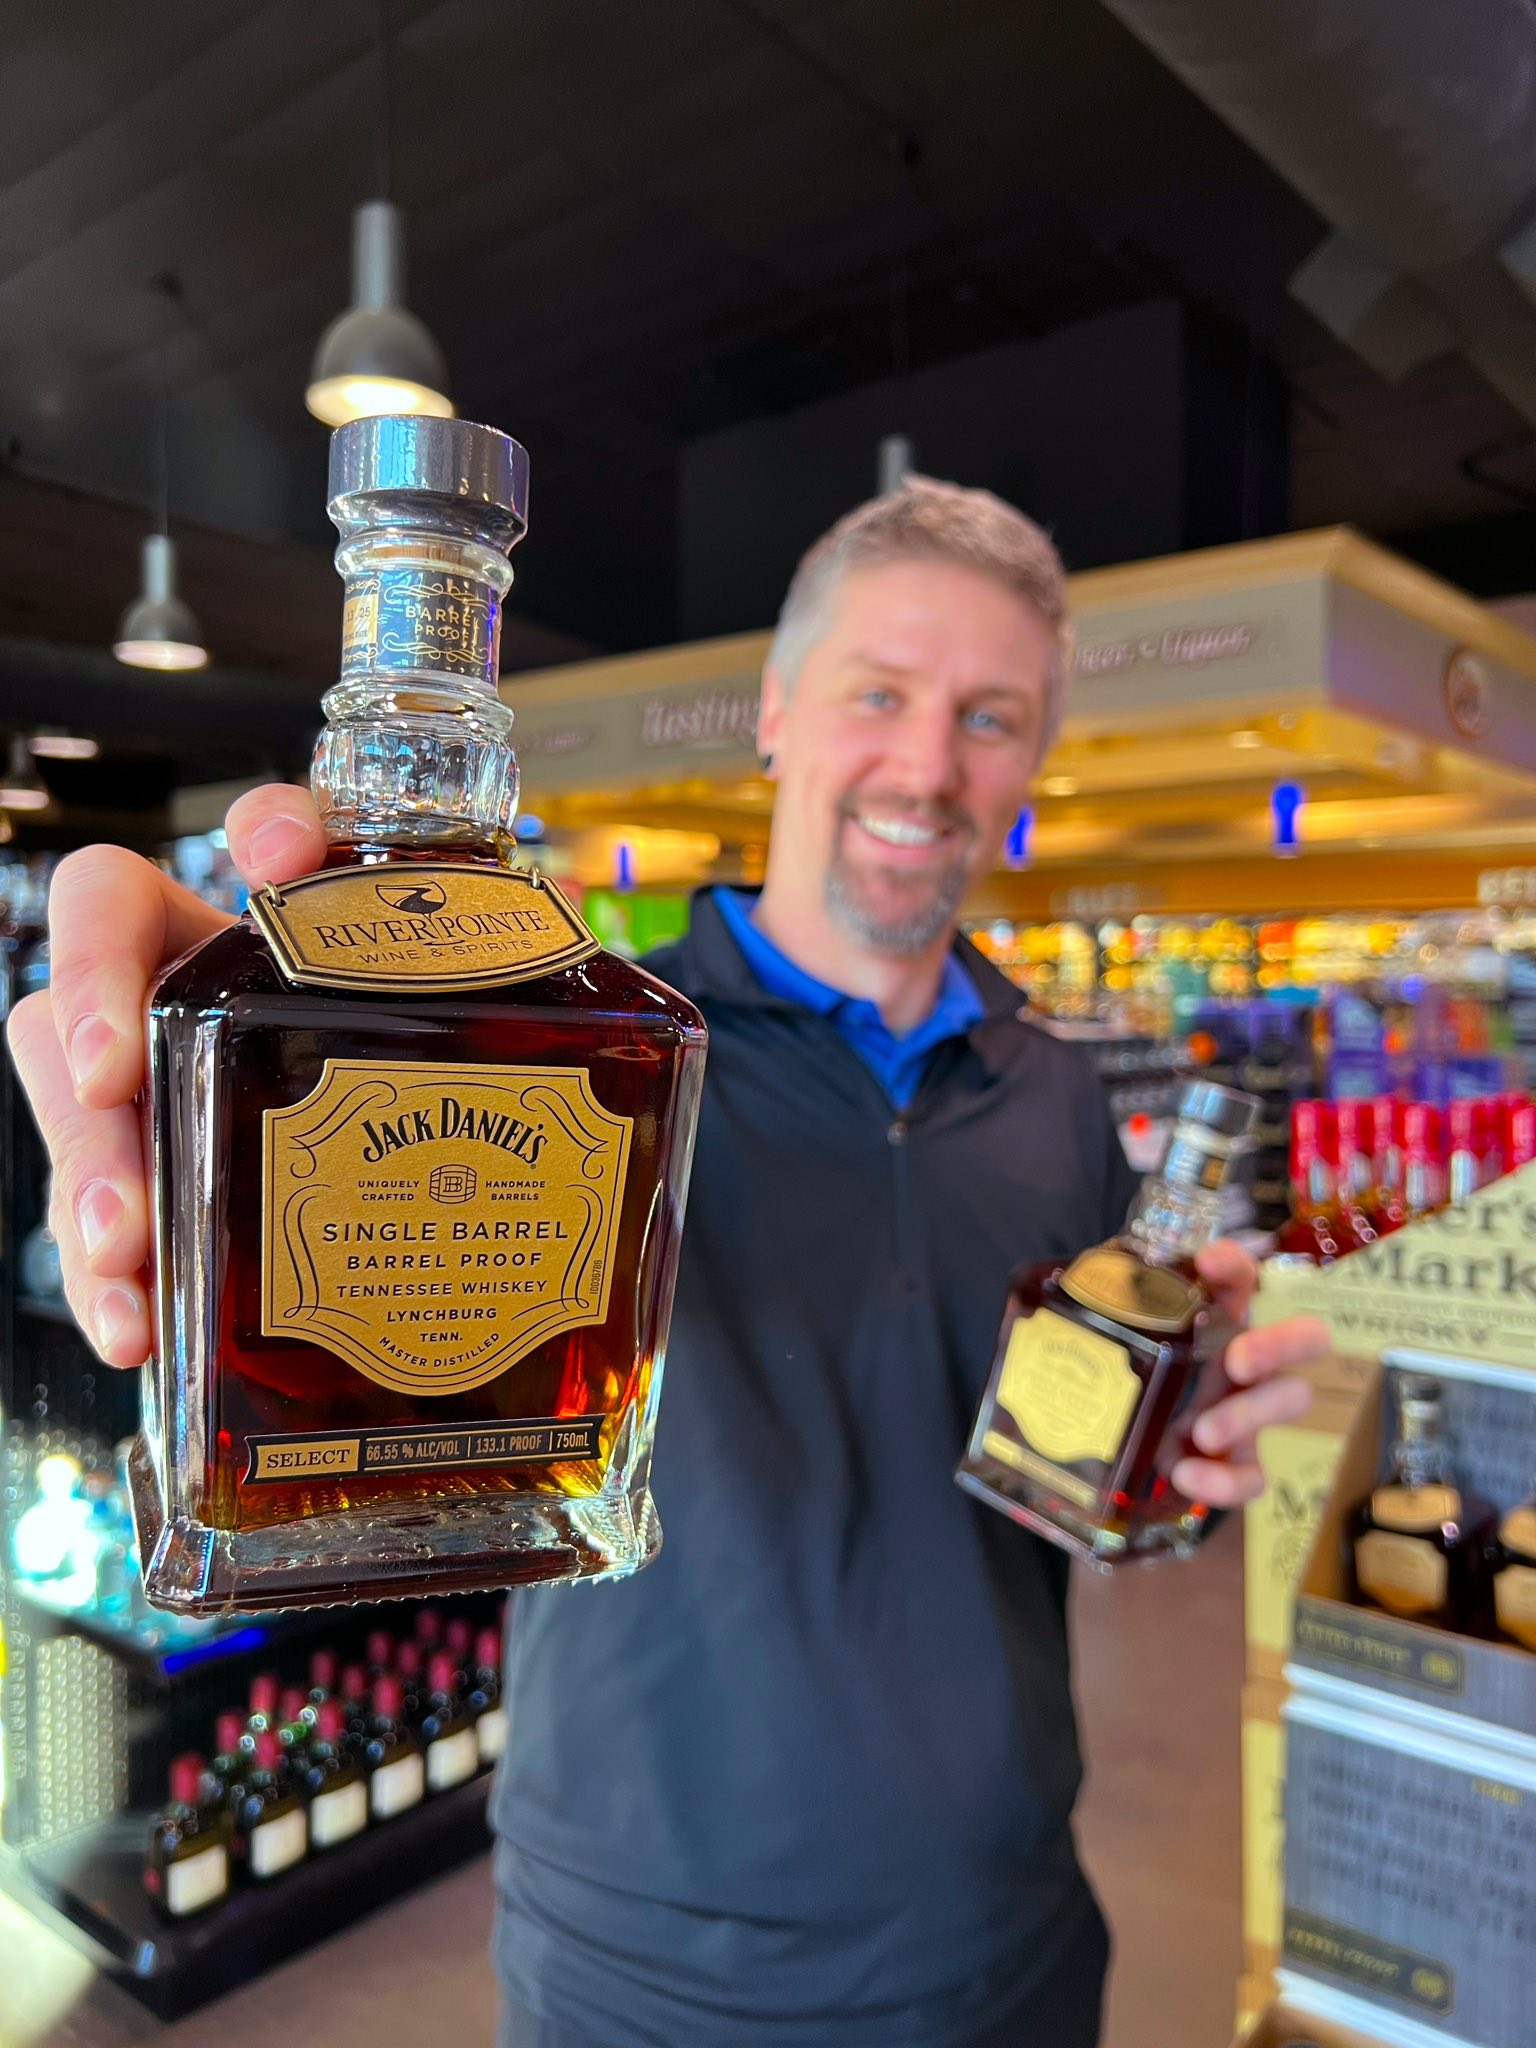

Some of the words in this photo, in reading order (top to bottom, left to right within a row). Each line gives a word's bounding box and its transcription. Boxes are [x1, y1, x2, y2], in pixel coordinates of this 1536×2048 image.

[415, 624, 470, 643] PROOF
[313, 920, 438, 949] RIVER
[438, 910, 549, 938] POINTE
[359, 948, 421, 964] WINE
[432, 947, 444, 958] &
[454, 940, 534, 956] SPIRITS
[360, 1108, 437, 1163] JACK
[439, 1097, 549, 1165] DANIEL'S
[358, 1180, 420, 1188] UNIQUELY
[485, 1180, 546, 1188] HANDMADE
[362, 1193, 414, 1201] CRAFTED
[491, 1193, 539, 1201] BARRELS
[322, 1222, 437, 1242] SINGLE
[452, 1221, 568, 1240] BARREL
[347, 1254, 446, 1270] BARREL
[461, 1253, 542, 1268] PROOF
[337, 1283, 453, 1298] TENNESSEE
[462, 1280, 548, 1295] WHISKEY
[387, 1308, 497, 1322] LYNCHBURG
[420, 1332, 463, 1343] TENN.
[379, 1336, 428, 1367] MASTER
[433, 1333, 500, 1367] DISTILLED
[366, 1444, 399, 1461] 66.55
[402, 1443, 415, 1459] %
[415, 1440, 460, 1459] ALC/VOL
[476, 1437, 506, 1454] 133.1
[509, 1436, 543, 1452] PROOF
[266, 1449, 350, 1468] SELECT
